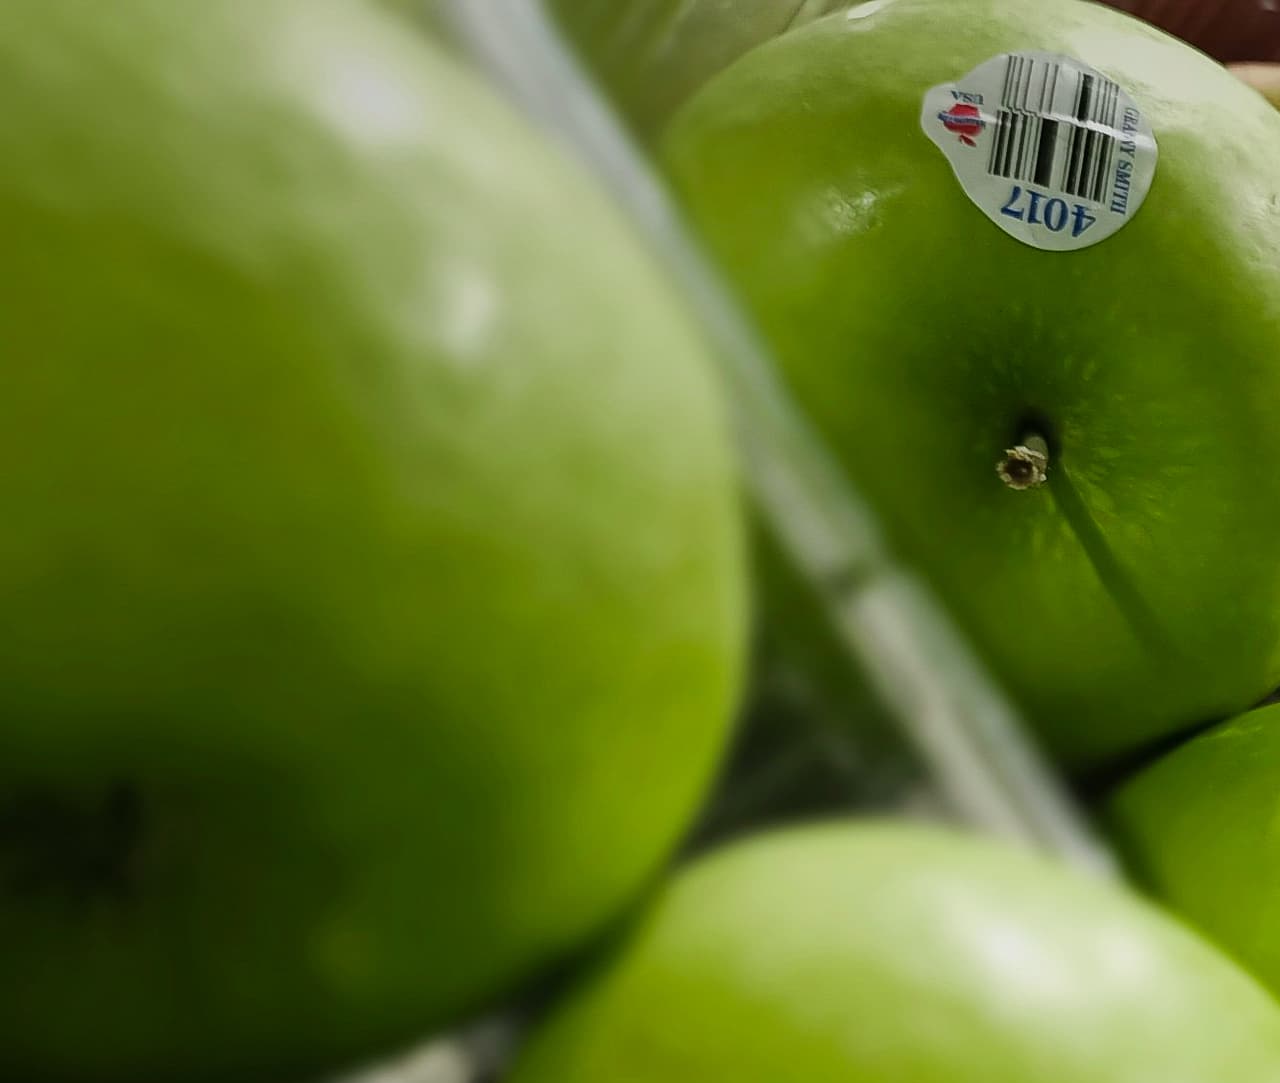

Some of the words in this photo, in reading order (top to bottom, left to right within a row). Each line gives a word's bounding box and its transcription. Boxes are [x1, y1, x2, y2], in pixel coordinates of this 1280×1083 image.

[950, 90, 984, 106] USA
[1000, 185, 1097, 238] 4017
[1110, 160, 1136, 216] SMITH
